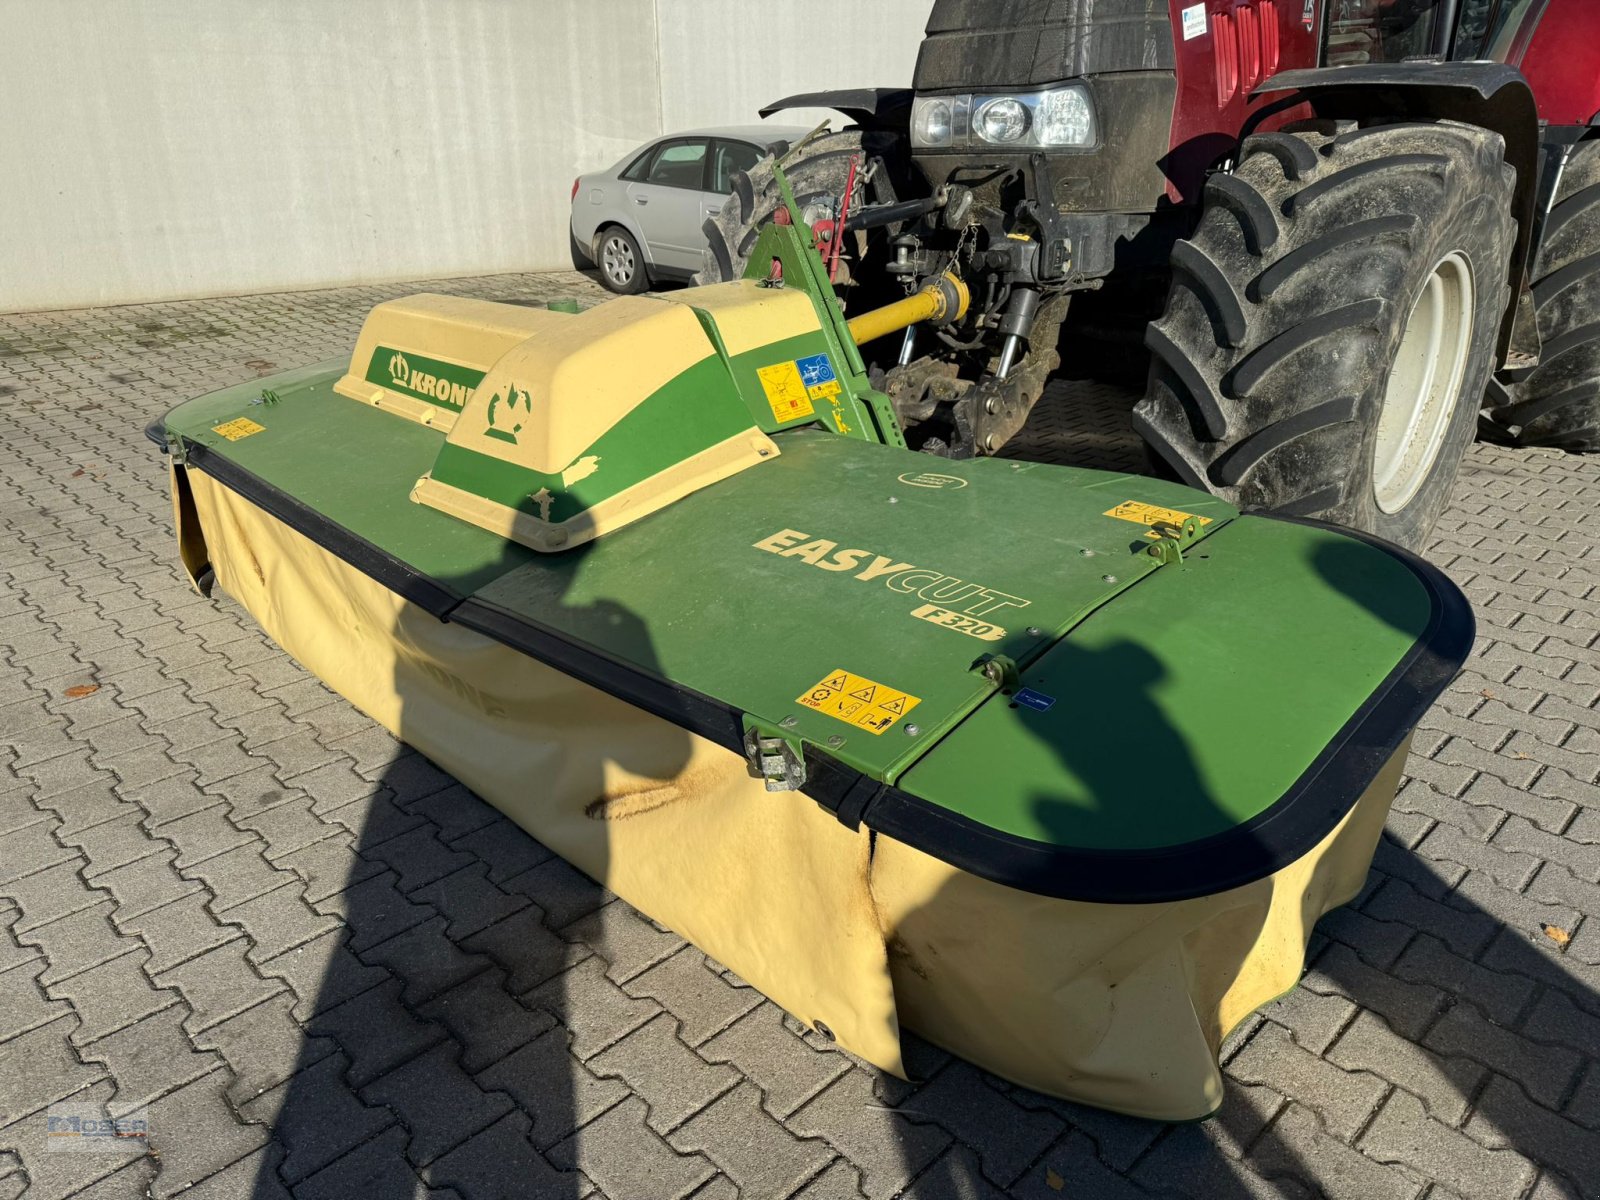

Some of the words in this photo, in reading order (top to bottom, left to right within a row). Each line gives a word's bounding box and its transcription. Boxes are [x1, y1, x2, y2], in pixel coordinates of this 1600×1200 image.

[752, 528, 1032, 616] EASYCUT
[923, 608, 943, 621] F
[941, 612, 994, 637] 320
[801, 697, 821, 707] STOP
